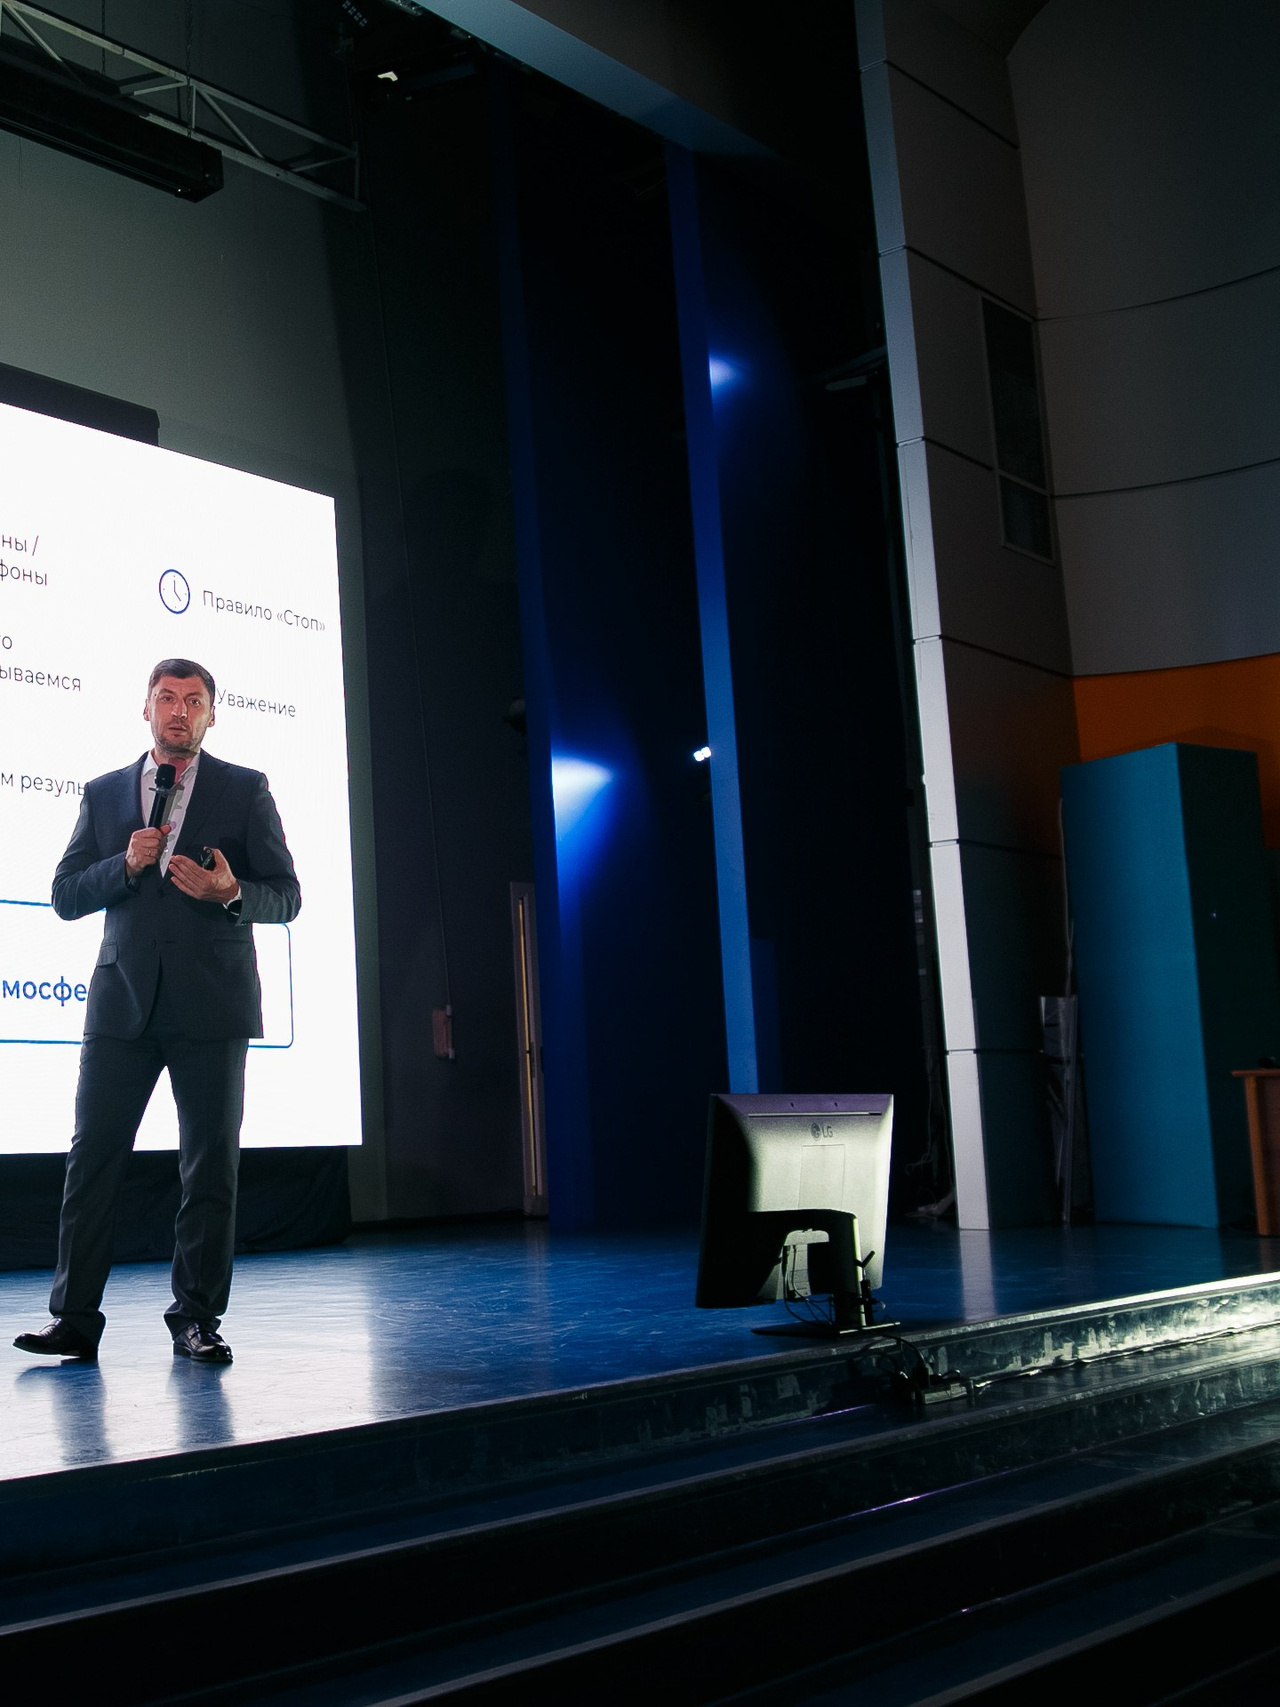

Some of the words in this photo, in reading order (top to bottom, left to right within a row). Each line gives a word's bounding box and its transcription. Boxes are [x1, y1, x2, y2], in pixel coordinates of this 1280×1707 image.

[32, 535, 39, 556] /
[203, 590, 273, 620] Правило
[277, 609, 326, 631] «Стоп»
[216, 688, 296, 717] Уважение
[21, 774, 86, 797] резуль
[821, 1125, 833, 1138] LG
